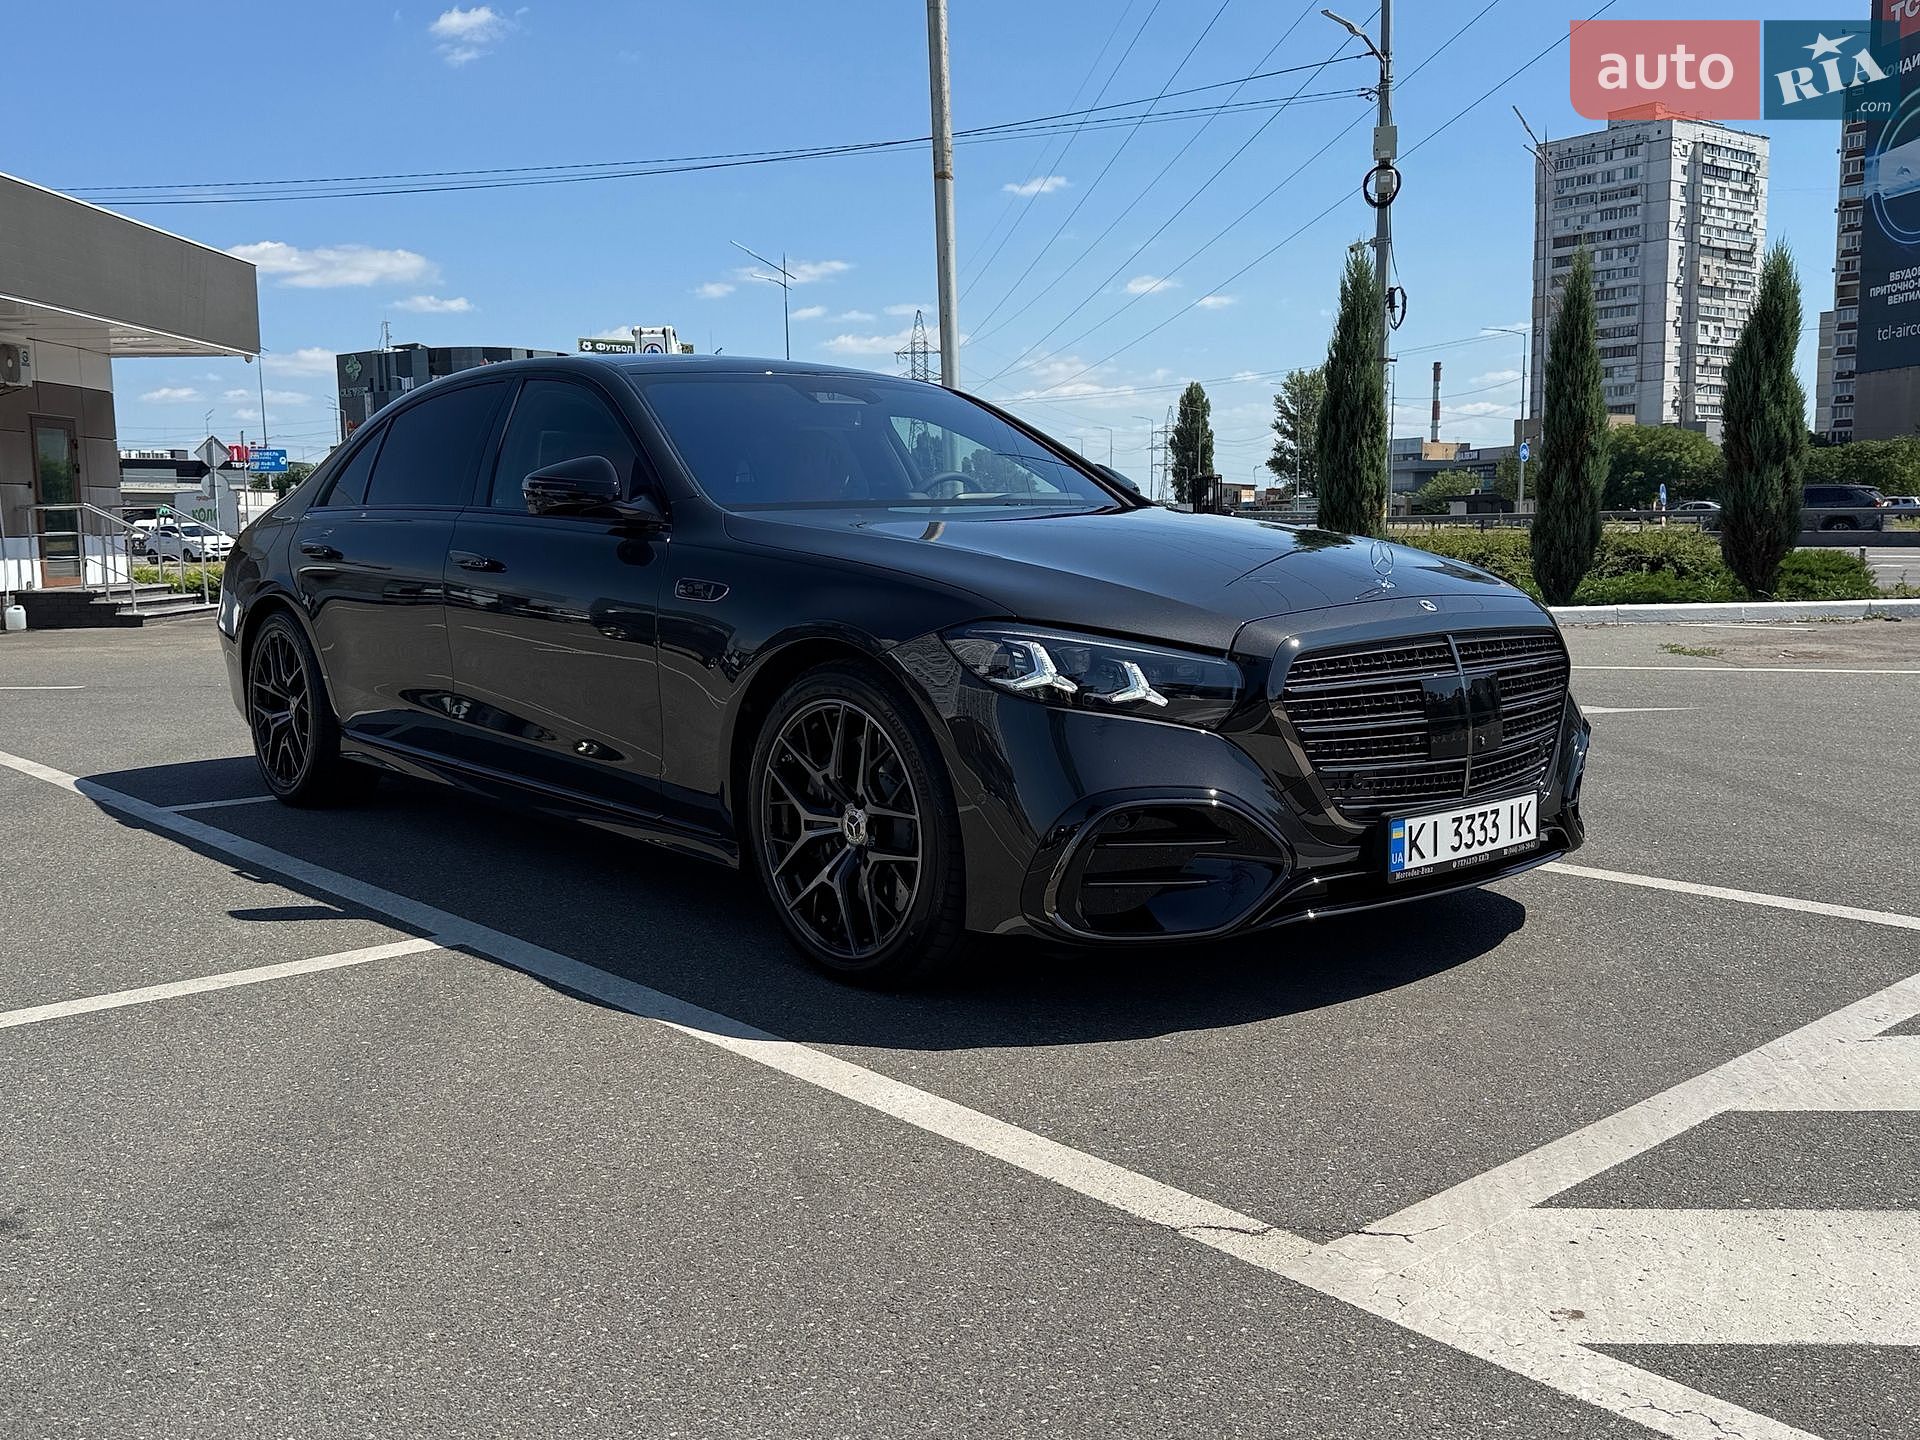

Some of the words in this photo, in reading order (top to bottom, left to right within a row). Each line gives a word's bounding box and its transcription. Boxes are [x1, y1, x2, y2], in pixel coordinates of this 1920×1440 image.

[1882, 53, 1920, 76] ОНДИ
[1408, 820, 1438, 862] KI
[1450, 808, 1500, 852] 3333
[1510, 800, 1532, 840] IK
[1391, 853, 1404, 864] UA
